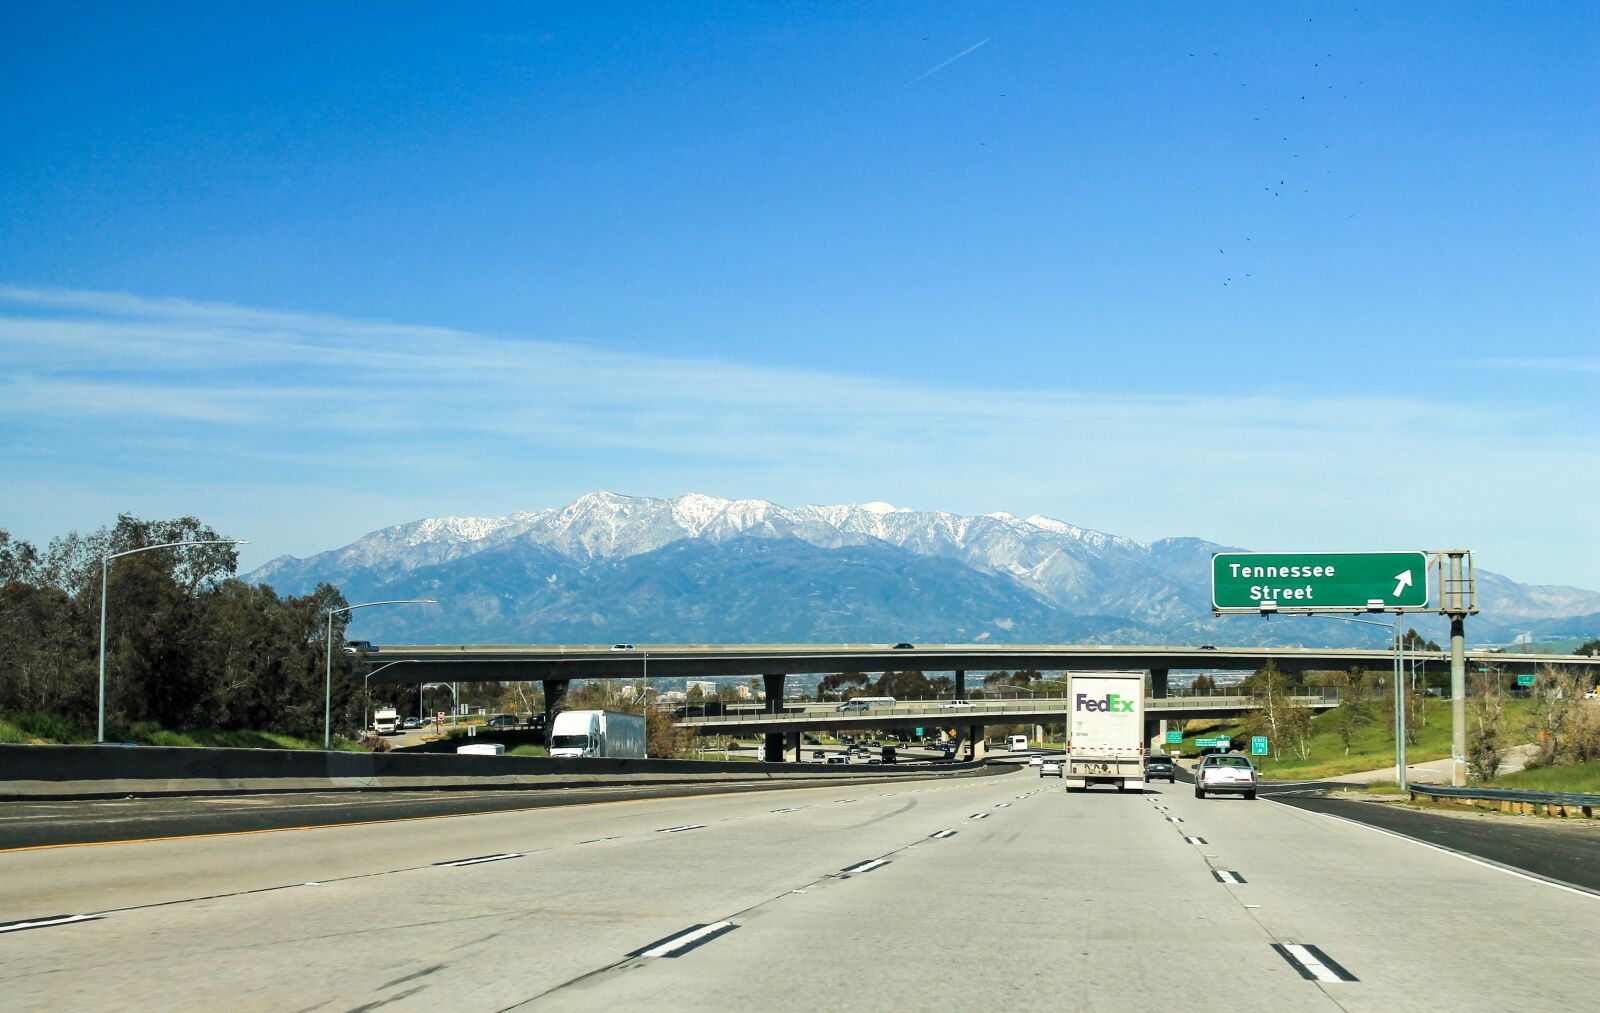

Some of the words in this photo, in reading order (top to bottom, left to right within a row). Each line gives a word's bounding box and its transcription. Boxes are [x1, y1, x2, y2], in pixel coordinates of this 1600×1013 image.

[1229, 563, 1335, 578] Tennessee
[1249, 584, 1313, 600] Street
[1076, 694, 1135, 713] FedEx
